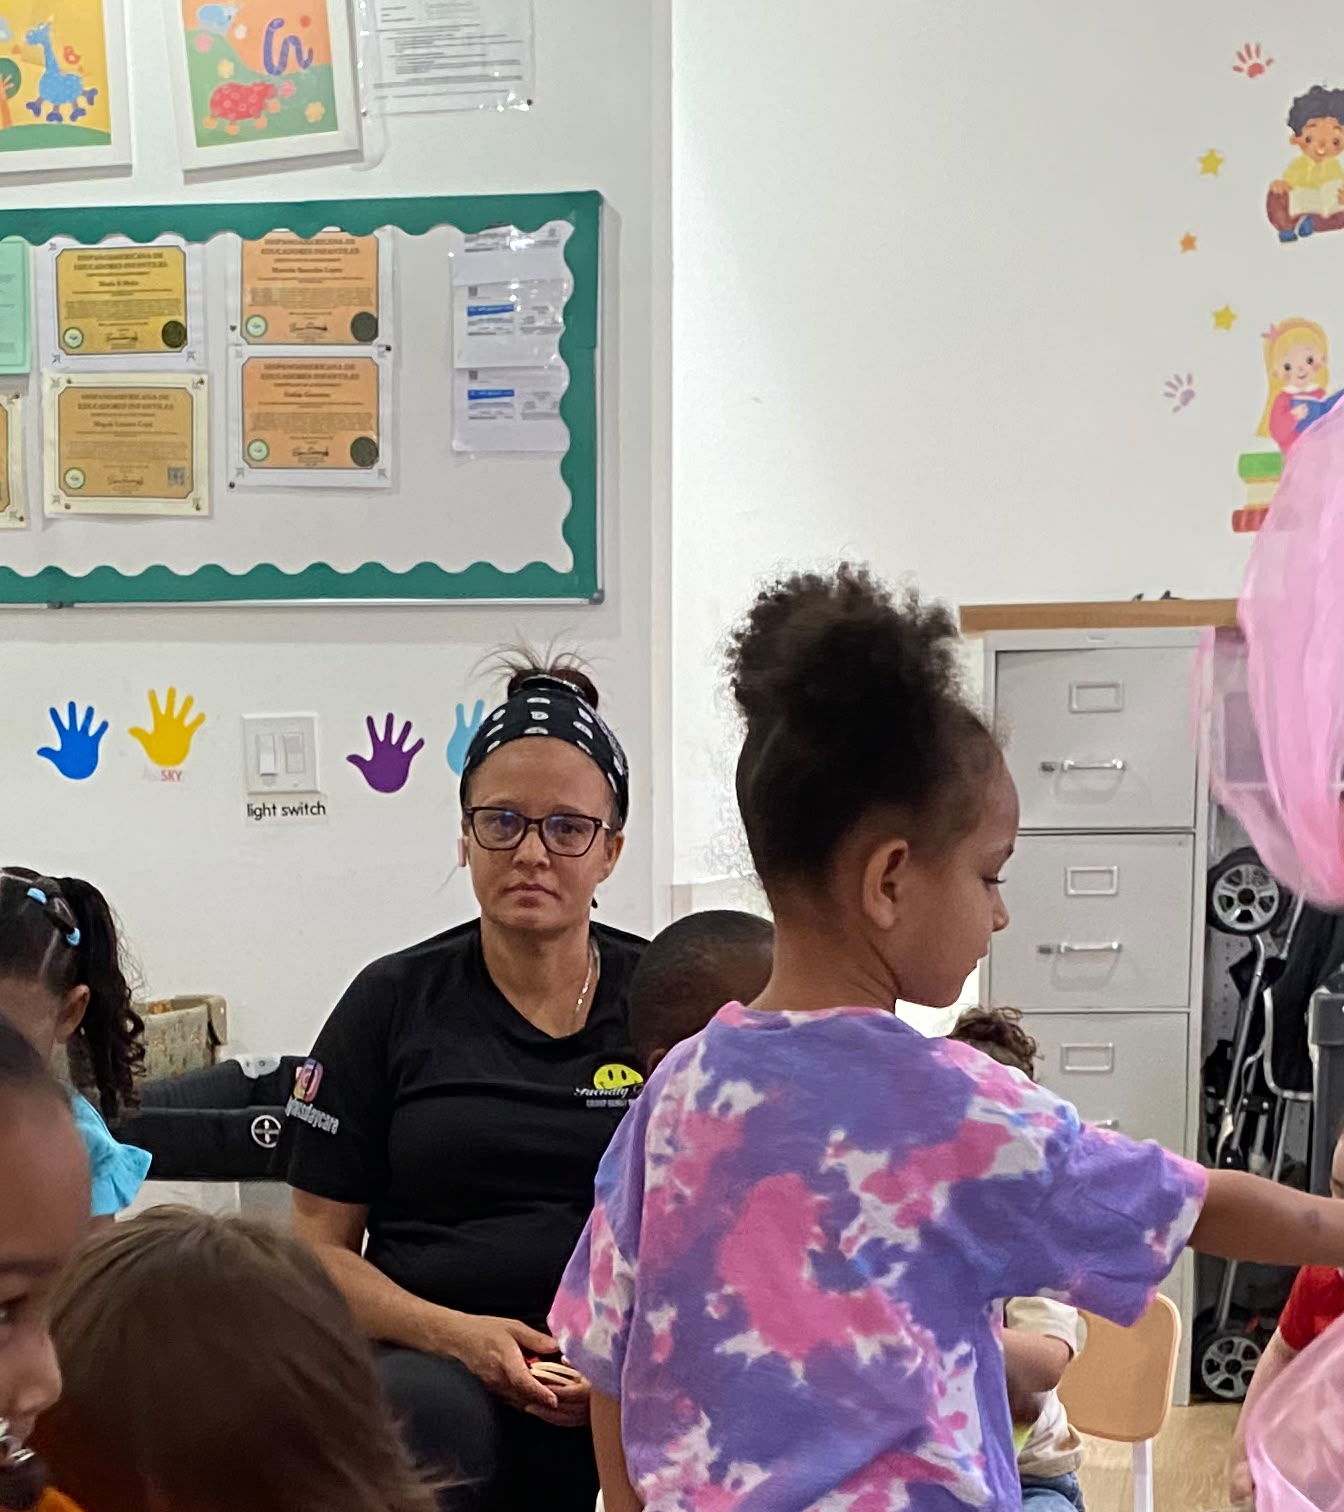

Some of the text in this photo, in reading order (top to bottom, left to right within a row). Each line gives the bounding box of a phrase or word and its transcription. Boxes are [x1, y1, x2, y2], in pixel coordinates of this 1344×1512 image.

[160, 769, 183, 783] SKY
[246, 801, 327, 821] light switch
